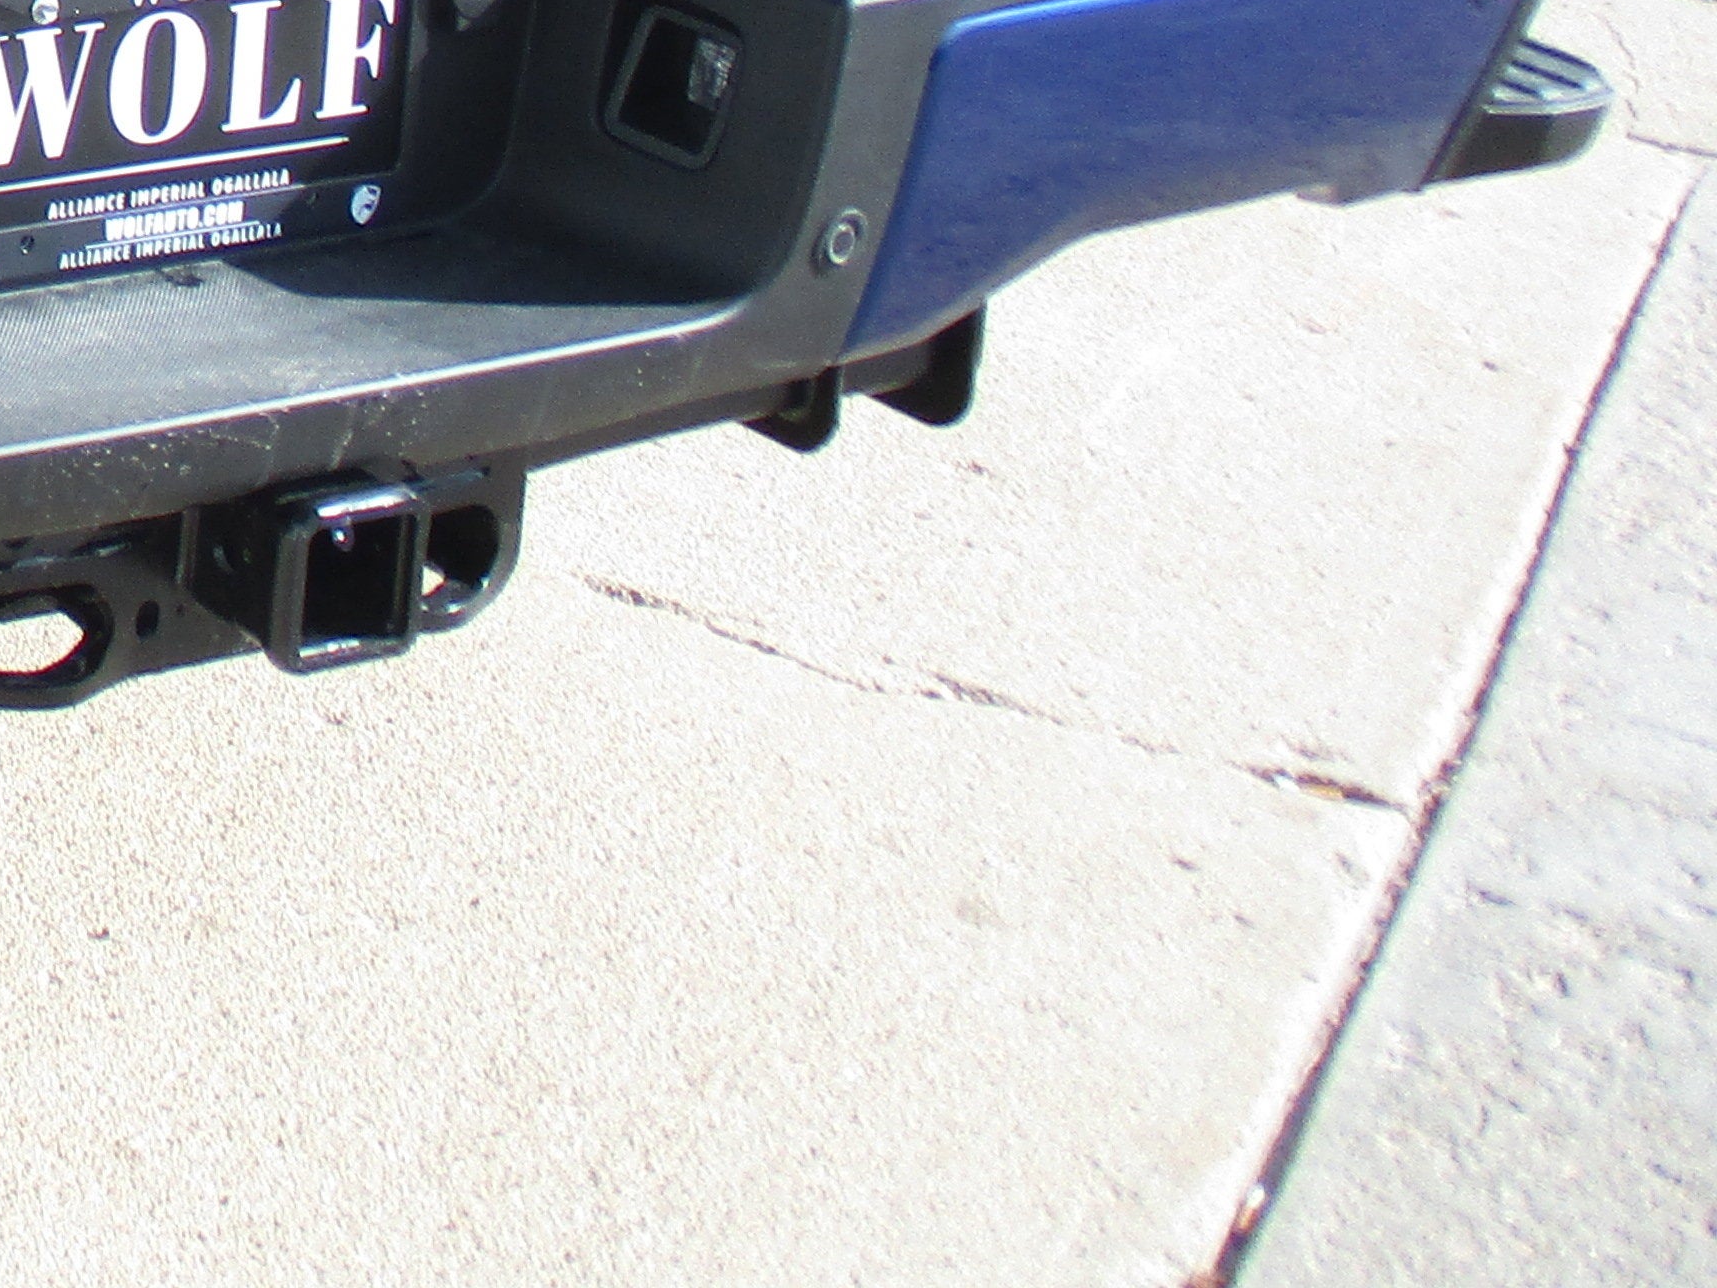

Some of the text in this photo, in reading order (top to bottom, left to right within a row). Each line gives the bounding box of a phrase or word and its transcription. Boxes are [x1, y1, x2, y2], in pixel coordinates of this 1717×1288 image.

[47, 168, 291, 220] ALLIANCE IMPERIAL OGALLALA
[105, 200, 246, 242] WOLFAUTO.COM
[59, 222, 283, 271] ALLIANCE IMPERIAL OGALLALA
